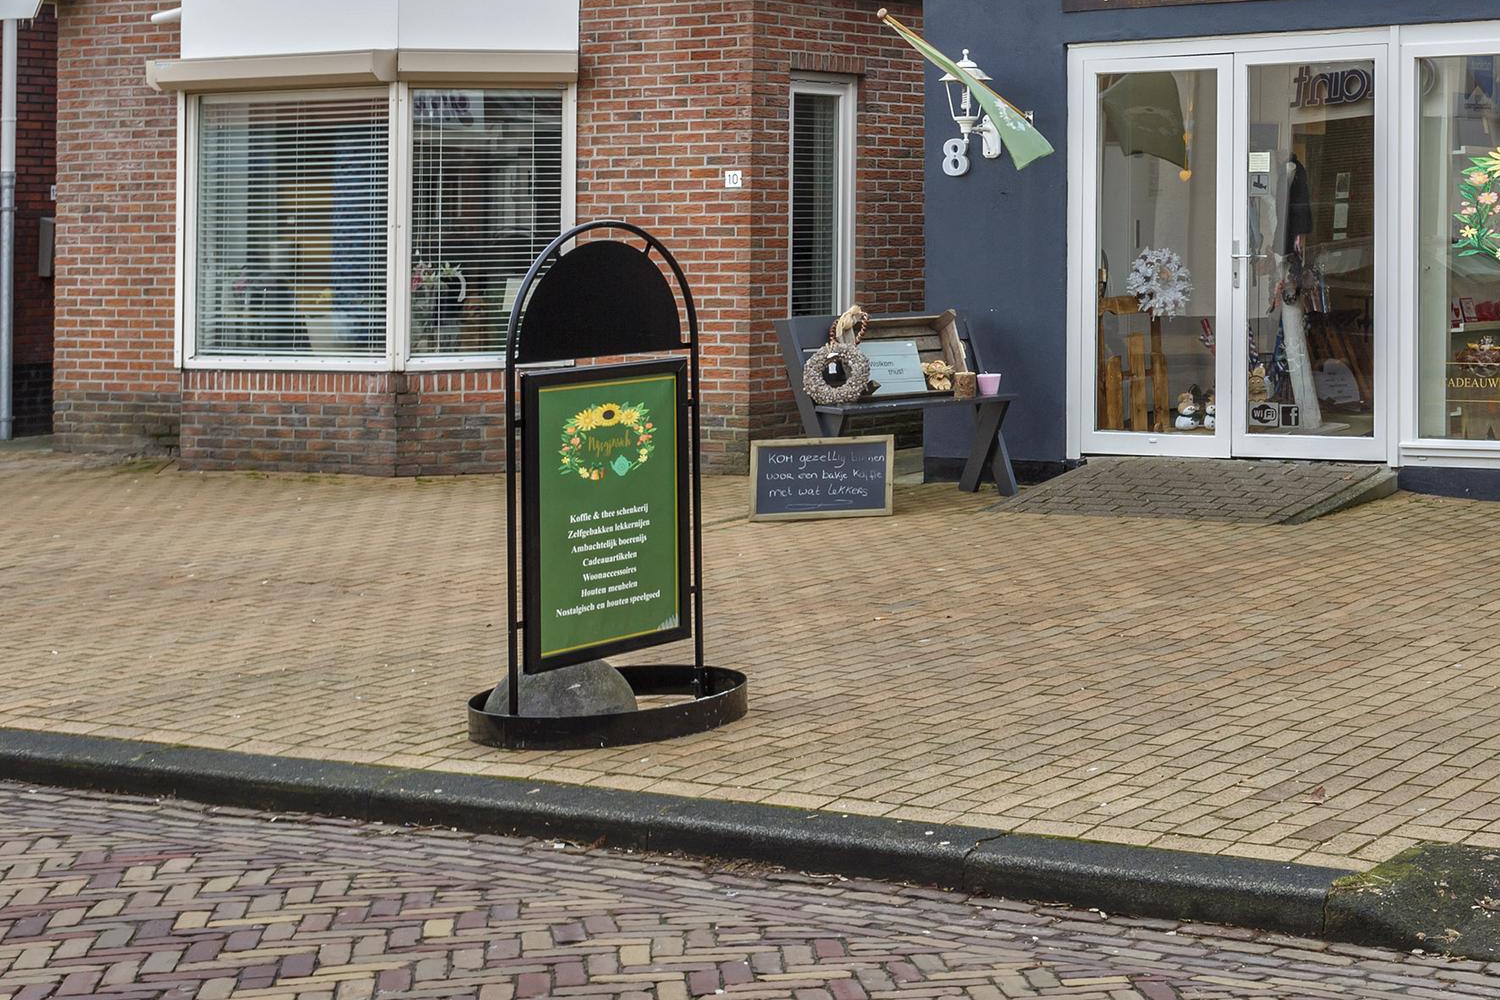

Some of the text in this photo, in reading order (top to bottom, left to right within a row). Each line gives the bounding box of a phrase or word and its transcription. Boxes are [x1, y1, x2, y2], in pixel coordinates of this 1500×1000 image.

[942, 137, 971, 177] 8
[728, 173, 739, 185] 10
[798, 487, 820, 496] wat
[570, 503, 649, 523] Koffie & thee schenkerij
[568, 518, 651, 539] Zelfgebakken lekkernijen
[571, 533, 647, 554] Ambachtelijk boerenijs
[582, 551, 638, 567] Cadeauartikelen
[582, 566, 637, 582] Woonaccessoires
[581, 580, 638, 598] Houten meubelen
[555, 589, 661, 618] Nostalgisch en houten speelgoed
